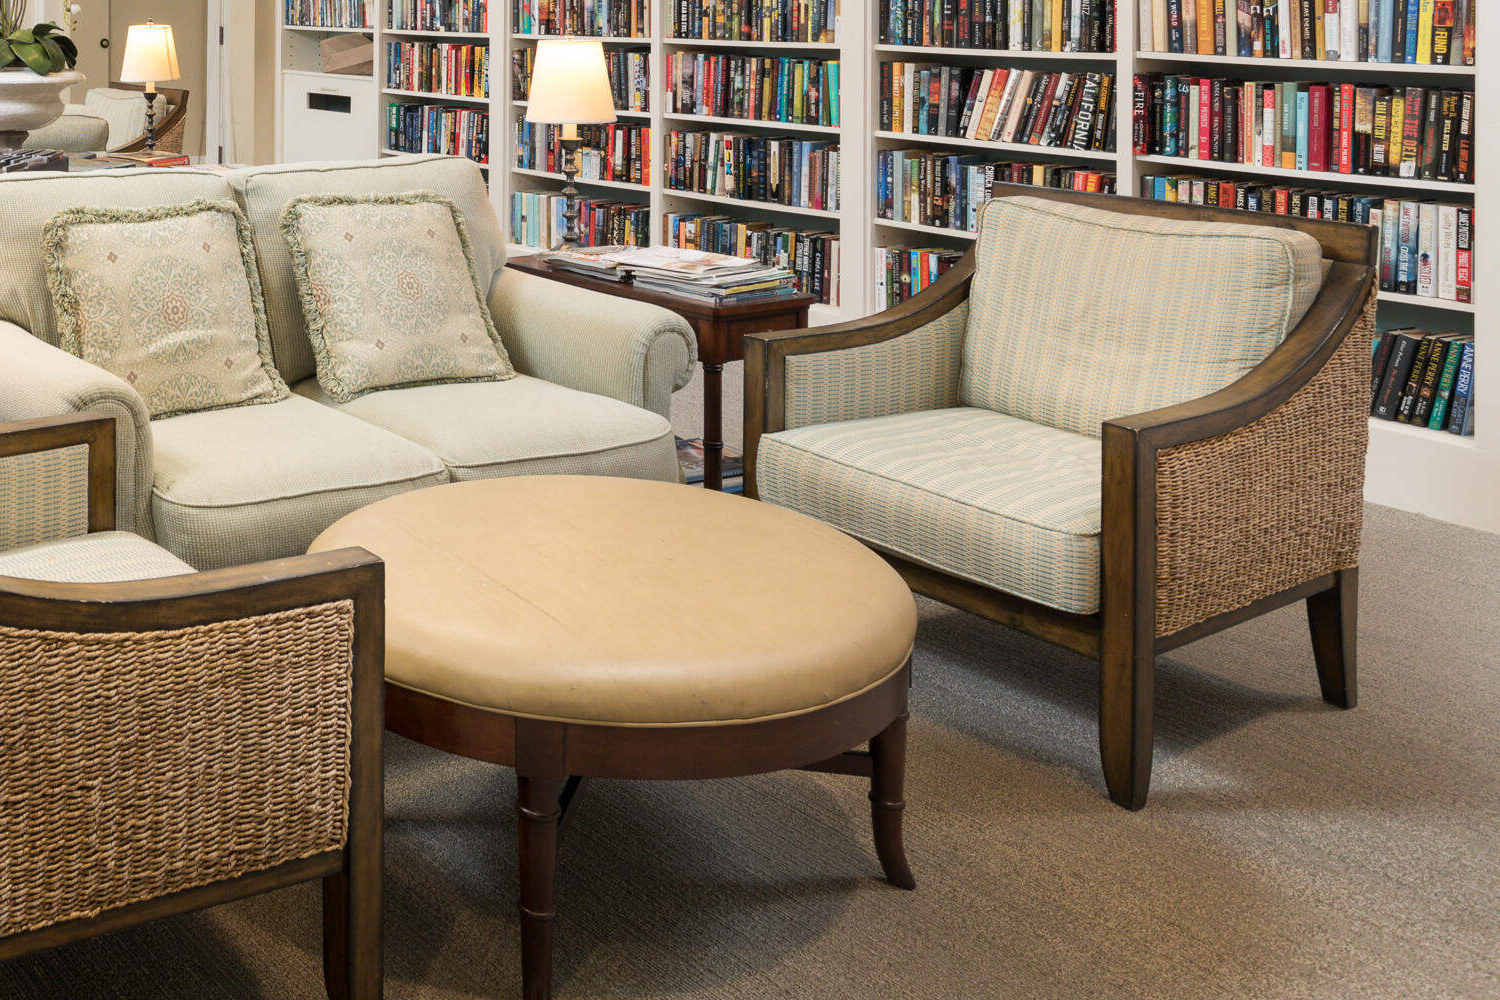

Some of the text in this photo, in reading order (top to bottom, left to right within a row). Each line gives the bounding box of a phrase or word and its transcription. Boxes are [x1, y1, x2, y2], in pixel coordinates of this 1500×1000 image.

[1073, 72, 1099, 151] CALIFORNIA
[1134, 92, 1144, 116] FIRE
[1403, 119, 1418, 165] THE DELT
[1410, 339, 1429, 382] ANNE PERRY
[1424, 340, 1443, 386] ANNE PERRY
[1448, 343, 1460, 363] ANNE
[1462, 345, 1474, 369] ANNE
[1442, 364, 1455, 389] PERRY
[1456, 369, 1470, 395] PERRY
